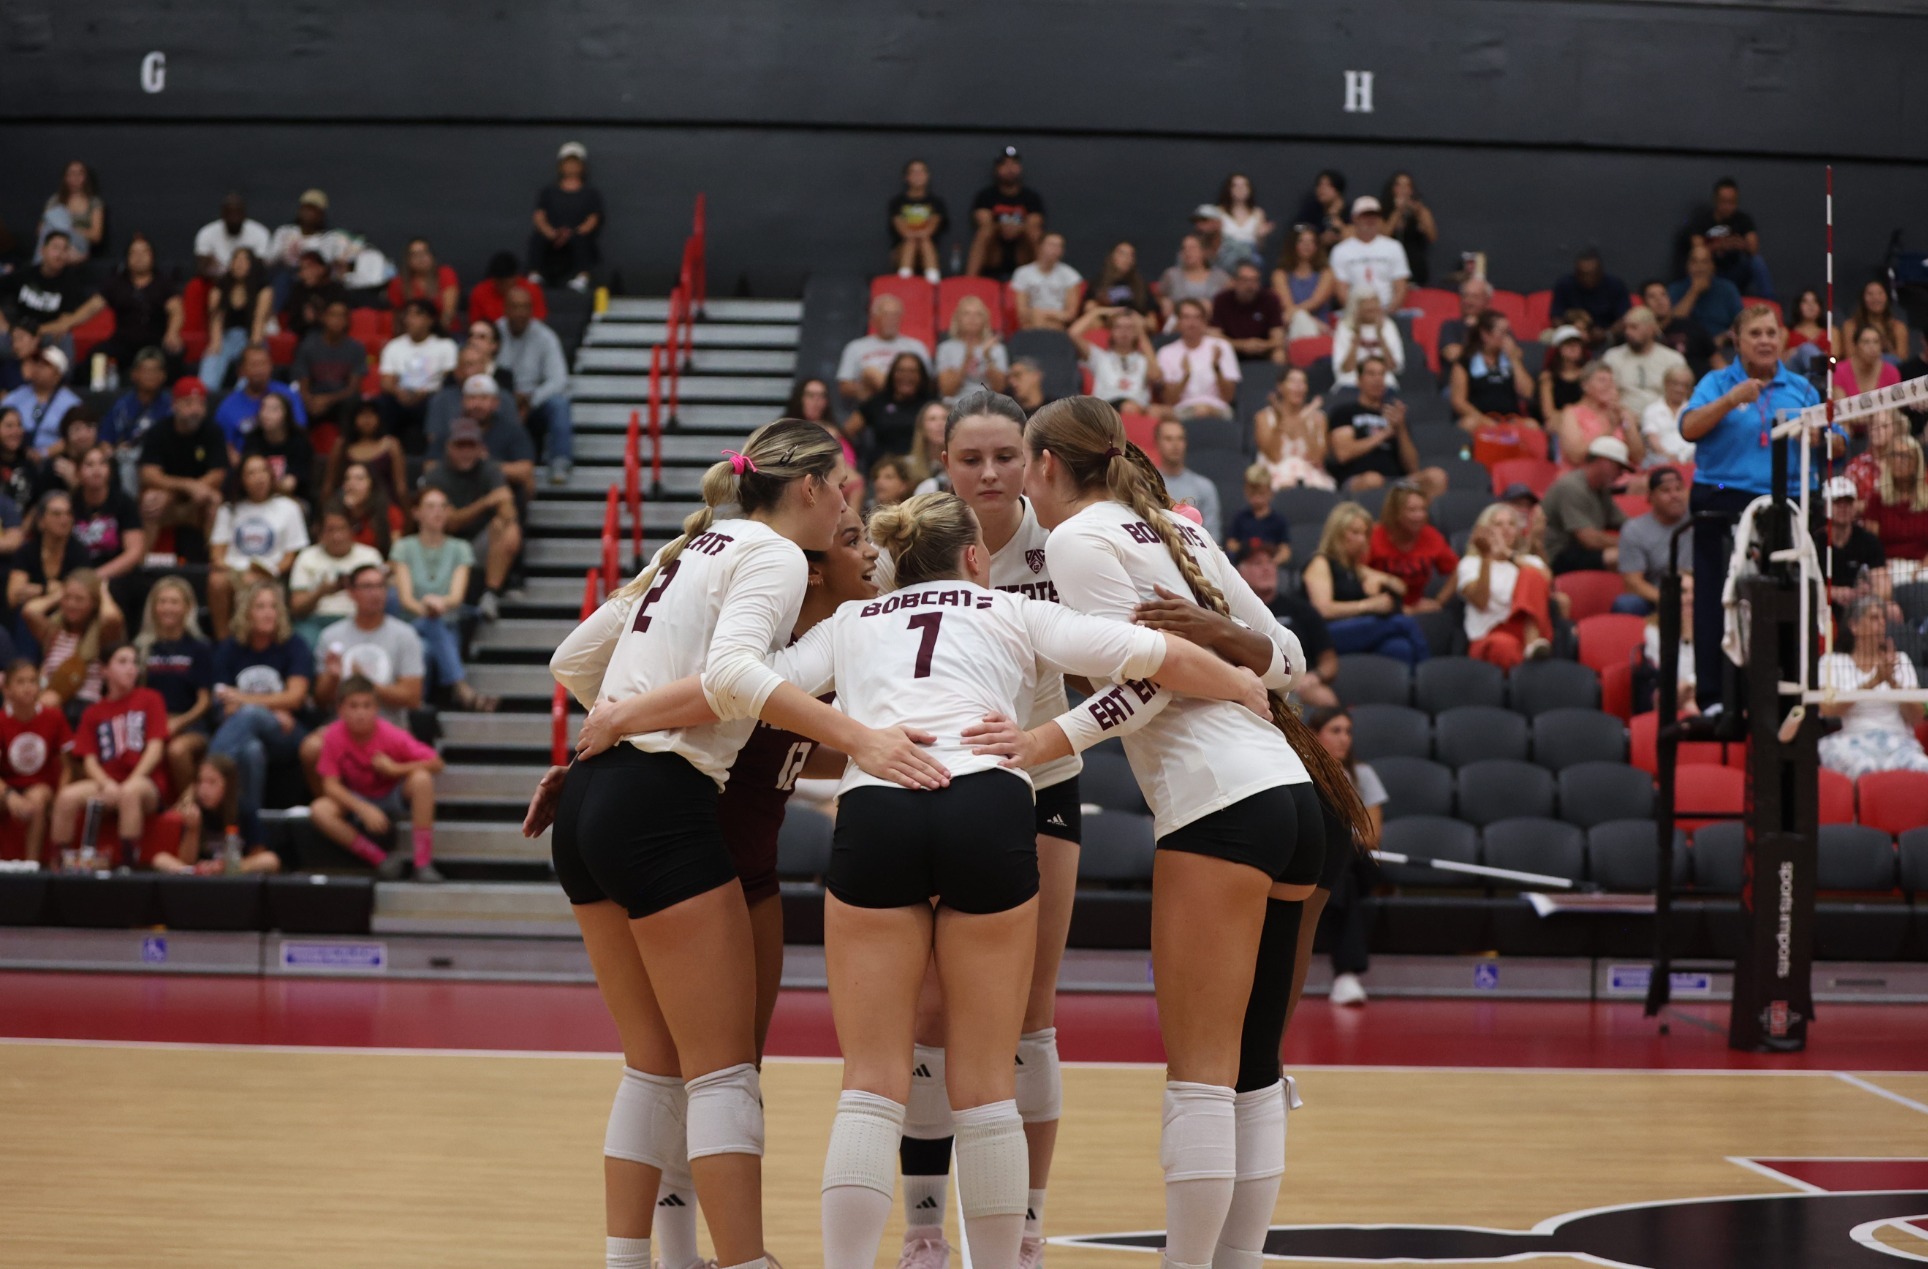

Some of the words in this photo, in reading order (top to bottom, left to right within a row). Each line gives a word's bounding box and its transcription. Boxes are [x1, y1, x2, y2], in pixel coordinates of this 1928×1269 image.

[141, 51, 166, 93] G
[1343, 70, 1375, 112] H
[684, 531, 735, 556] ATS
[631, 559, 681, 634] 2
[860, 590, 993, 617] BOBCATS
[994, 580, 1060, 604] ATE
[1088, 685, 1135, 731] EAT
[775, 741, 812, 791] 12
